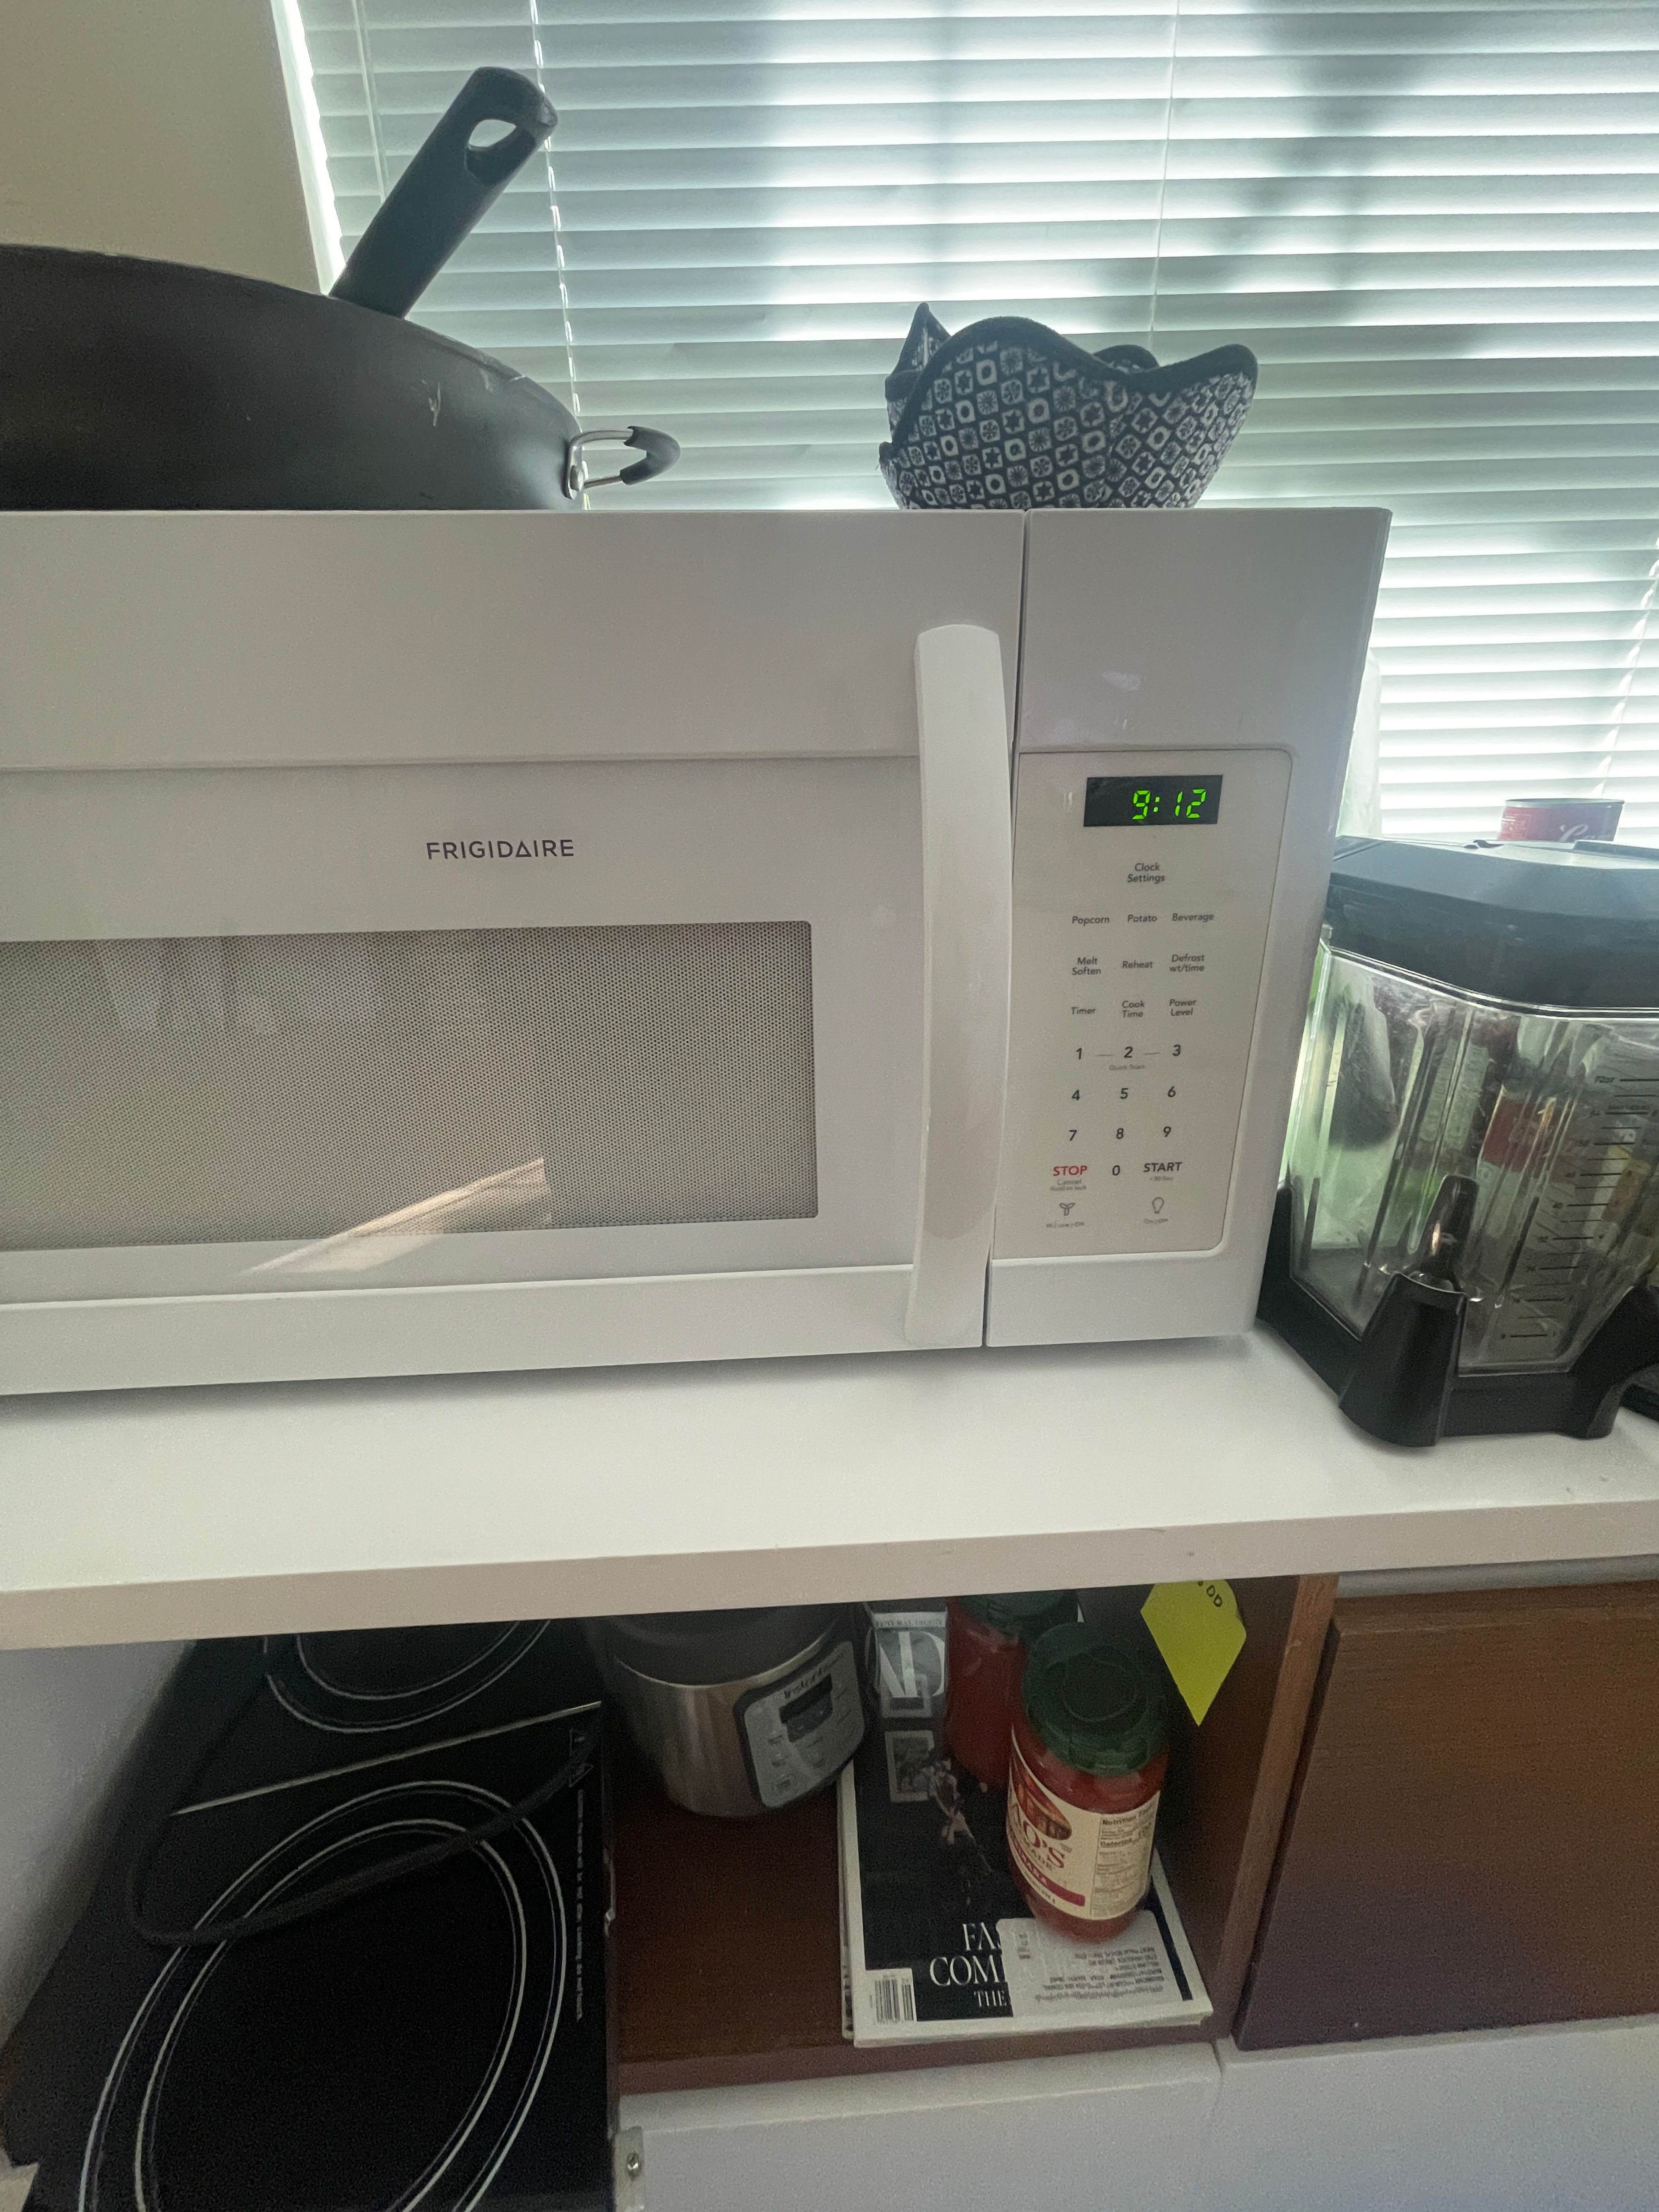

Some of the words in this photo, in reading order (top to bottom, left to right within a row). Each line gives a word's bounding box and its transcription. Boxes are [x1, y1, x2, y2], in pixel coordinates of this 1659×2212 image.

[1131, 789, 1207, 820] 9:12
[426, 839, 574, 860] FRIGIDAIRE
[1135, 862, 1160, 871] Clock
[1127, 874, 1165, 884] Settings
[1072, 916, 1110, 926] Popcorn
[1127, 914, 1157, 922] Potato
[1172, 913, 1214, 923] Beverage
[1077, 957, 1098, 966] Melt
[1171, 953, 1205, 963] Defrost
[1122, 960, 1153, 969] Reheat
[1170, 963, 1205, 973] wt/time
[1071, 967, 1102, 976] Soften
[1122, 1000, 1145, 1008] Cook
[1169, 998, 1197, 1007] Power
[1071, 1007, 1096, 1015] Timer
[1122, 1010, 1144, 1018] Time
[1170, 1008, 1193, 1016] Level
[1076, 1047, 1083, 1060] 1
[1124, 1046, 1133, 1058] 2
[1172, 1044, 1181, 1057] 3
[1071, 1089, 1081, 1101] 4
[1120, 1087, 1129, 1100] 5
[1167, 1086, 1176, 1098] 6
[1068, 1129, 1078, 1141] 7
[1116, 1128, 1125, 1139] 8
[1163, 1126, 1172, 1138] 9
[1053, 1165, 1088, 1176] STOP
[1112, 1165, 1121, 1176] 0
[1143, 1161, 1183, 1173] START
